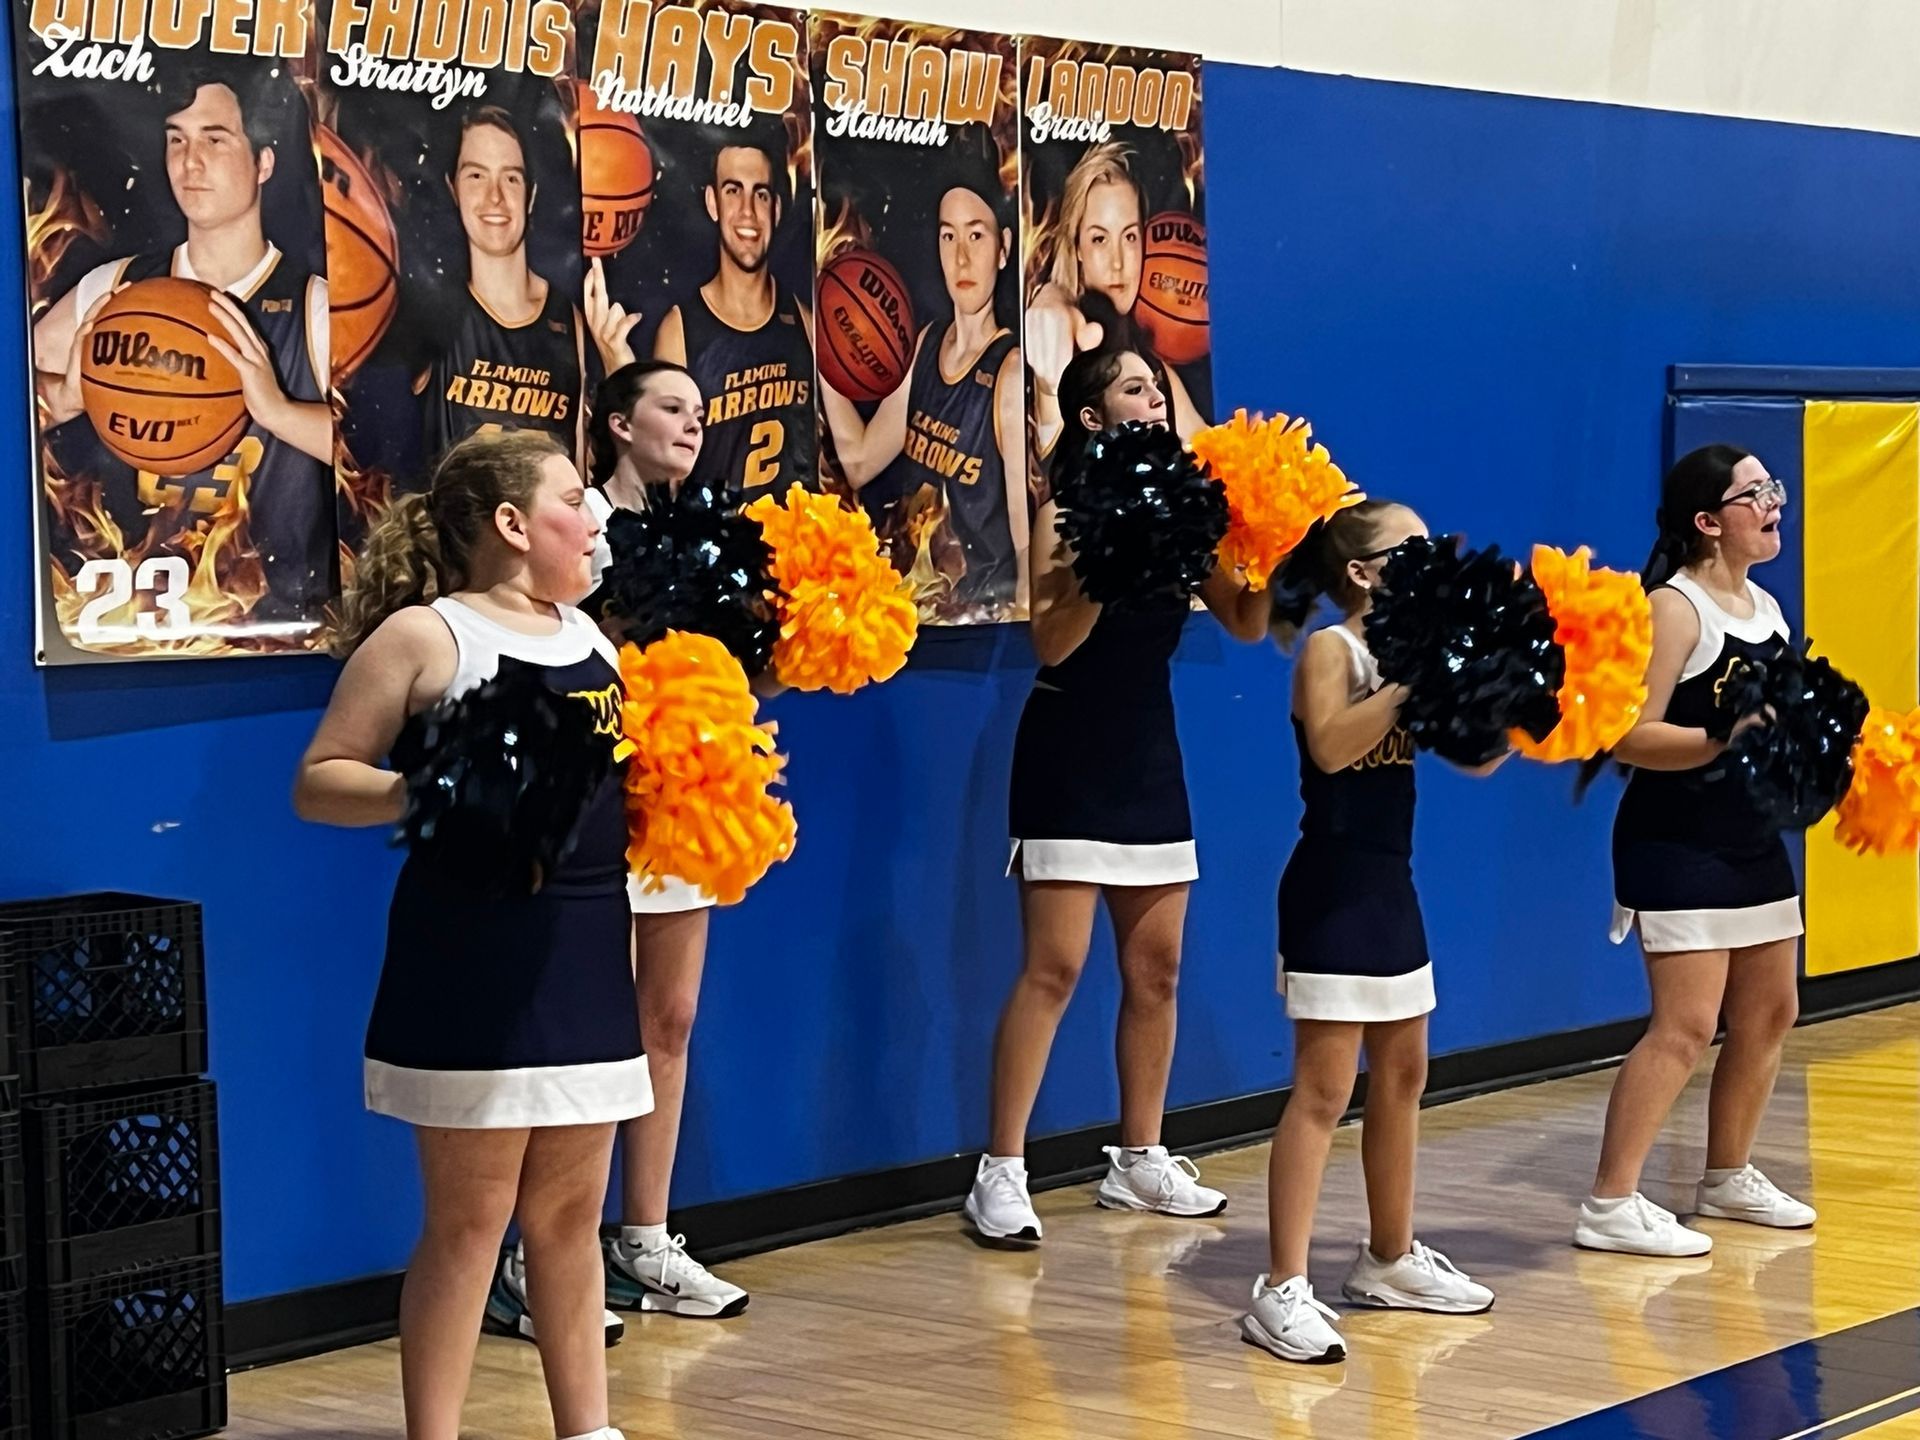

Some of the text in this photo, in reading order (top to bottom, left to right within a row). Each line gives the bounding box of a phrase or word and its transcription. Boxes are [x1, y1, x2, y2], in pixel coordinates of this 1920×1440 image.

[32, 22, 155, 83] Zach
[330, 42, 488, 110] Strattyn
[590, 0, 799, 114] HAYS
[595, 68, 753, 128] Nathaniel
[823, 34, 1003, 127] SHAW
[1025, 55, 1194, 133] LANDON
[825, 96, 949, 147] Hannah
[1029, 101, 1112, 144] Gracie
[92, 330, 208, 381] Wilson
[470, 359, 551, 386] FLAMING
[724, 363, 787, 390] FLAMING
[446, 375, 570, 420] ARROWS
[705, 380, 809, 427] ARROWS
[109, 411, 175, 442] EVO
[910, 410, 961, 445] LAMING
[743, 420, 784, 489] 2
[76, 555, 191, 645] 23
